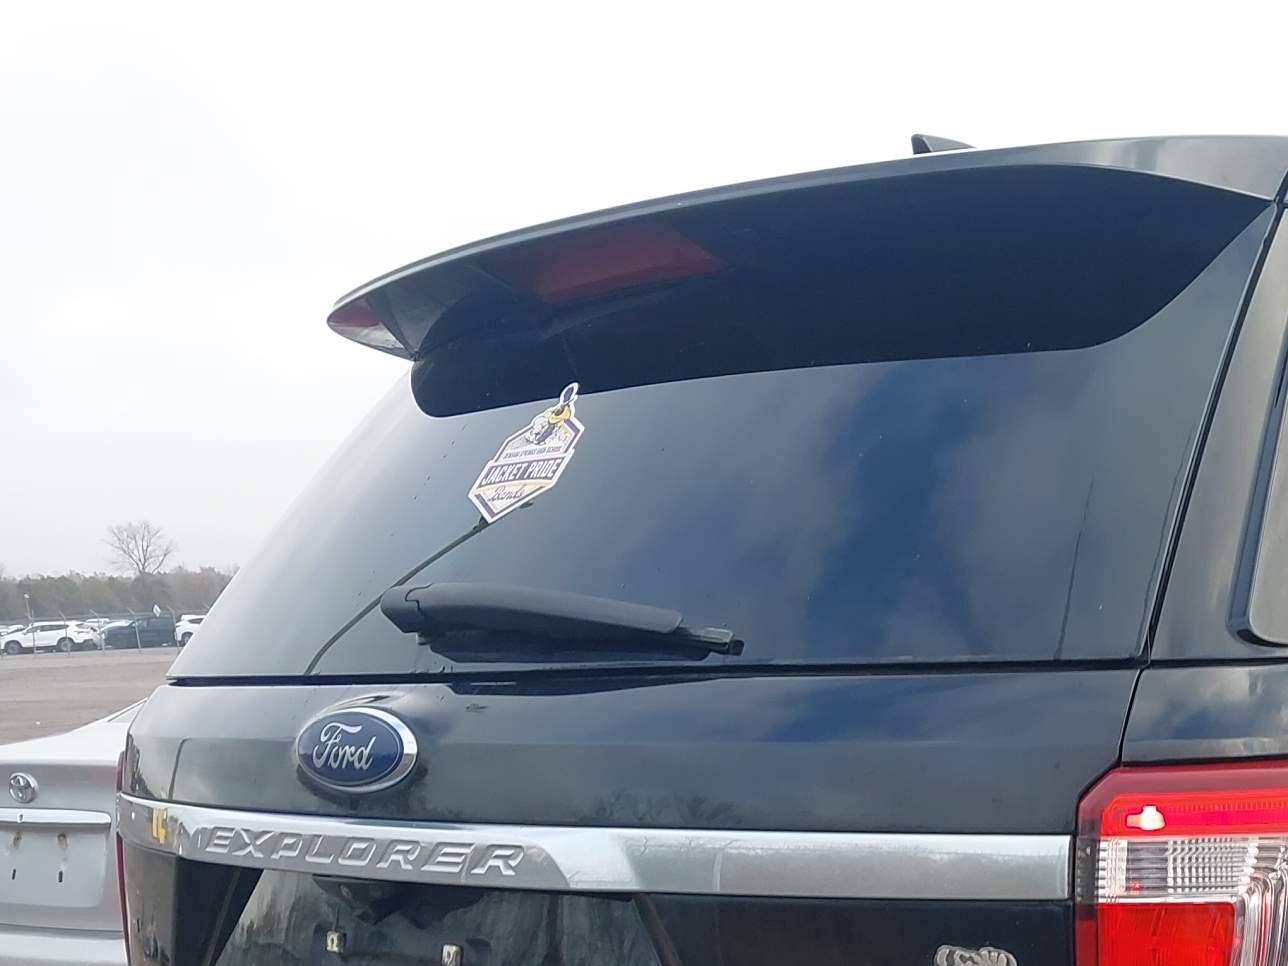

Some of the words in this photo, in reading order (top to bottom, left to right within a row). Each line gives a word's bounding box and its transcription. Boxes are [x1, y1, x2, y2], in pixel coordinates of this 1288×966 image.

[482, 462, 529, 485] JACKET
[523, 459, 562, 479] PRIDE
[312, 722, 376, 771] Ford
[204, 826, 526, 876] EXPLORER
